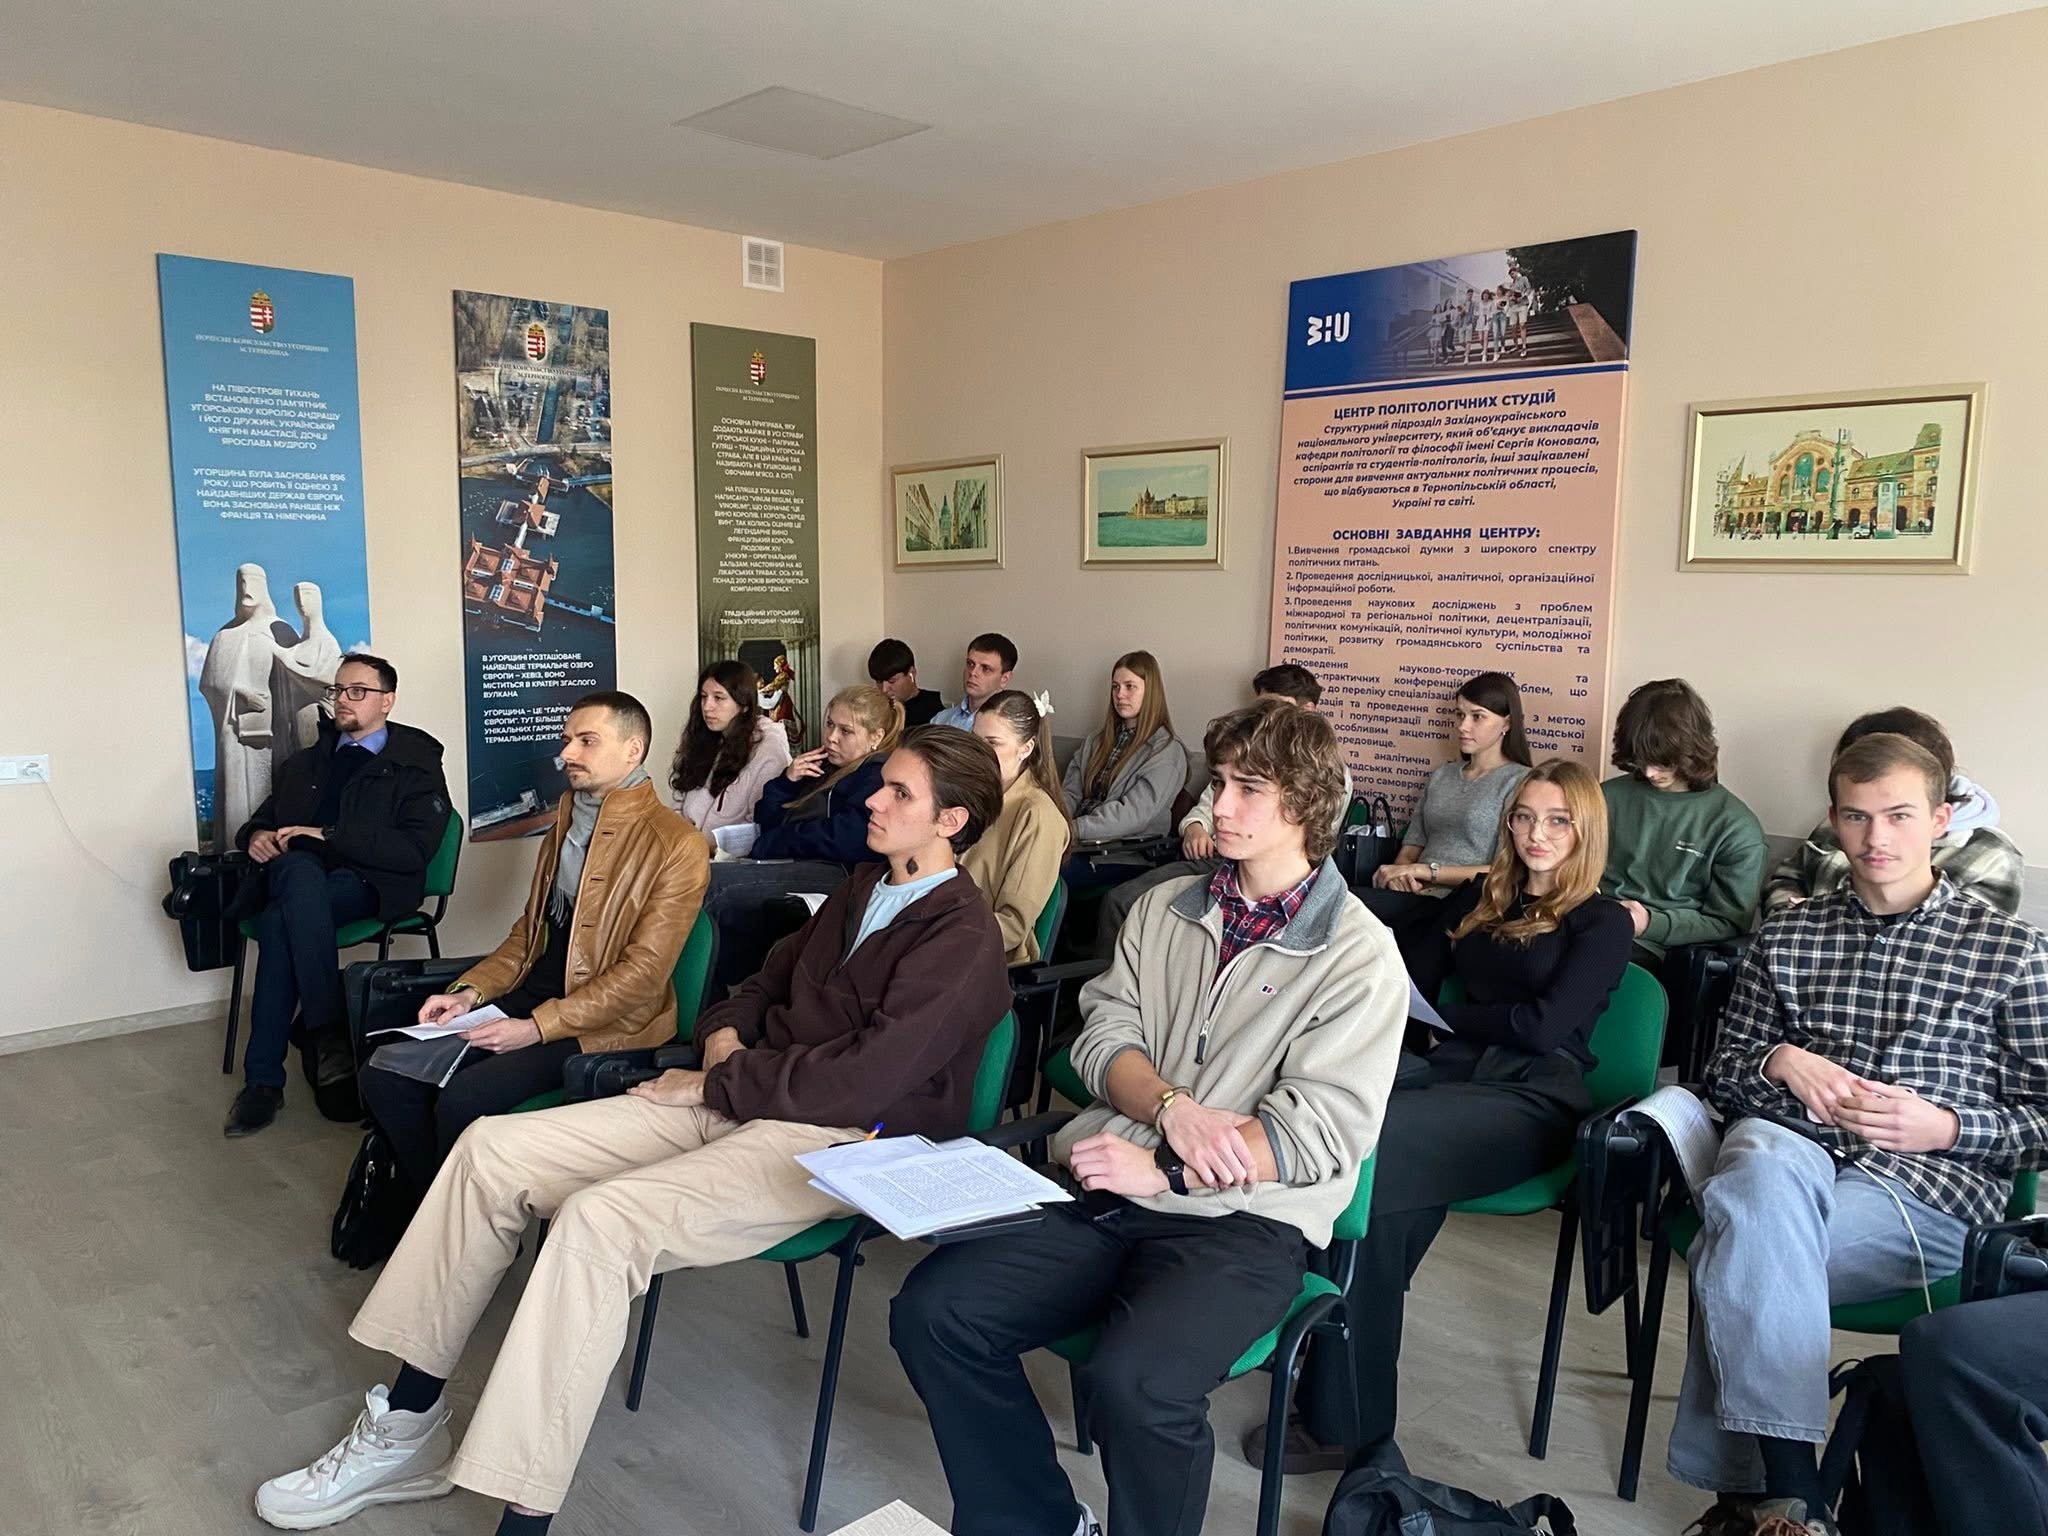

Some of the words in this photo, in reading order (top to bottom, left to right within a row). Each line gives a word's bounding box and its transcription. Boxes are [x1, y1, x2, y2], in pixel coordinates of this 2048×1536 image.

[1334, 406, 1375, 420] ЦЕНТР
[1378, 396, 1497, 416] ПОЛІТОЛОГІЧНИХ
[1502, 389, 1555, 406] СТУДІЙ
[1324, 420, 1389, 435] Структурний
[1391, 416, 1442, 430] підрозділ
[1444, 410, 1566, 426] Західноукраїнського
[1297, 437, 1370, 448] національного
[1372, 432, 1443, 446] університету,
[1446, 428, 1473, 442] який
[1476, 426, 1526, 437] об'єднує
[1529, 420, 1599, 434] викладачів
[1295, 451, 1339, 464] кафедри
[1340, 446, 1395, 462] політології
[1398, 447, 1409, 455] та
[1411, 442, 1463, 459] філософії
[1465, 440, 1494, 455] імені
[1497, 438, 1534, 453] Сергія
[1537, 437, 1599, 452] Коновала,
[1302, 461, 1354, 473] аспірантів
[1357, 462, 1367, 470] та
[1370, 454, 1487, 471] студентів-політологів,
[1490, 452, 1515, 467] інші
[1518, 449, 1589, 462] зацікавлені
[1294, 477, 1333, 486] сторони
[1334, 476, 1353, 487] для
[1355, 473, 1404, 487] вивчення
[1406, 470, 1470, 482] актуальних
[1473, 467, 1538, 480] політичних
[1541, 462, 1598, 477] процесів,
[1341, 485, 1411, 497] відбуваються
[1413, 485, 1419, 493] в
[1423, 480, 1507, 494] Тернопільській
[1509, 478, 1556, 490] області,
[1393, 497, 1432, 510] Україні
[1434, 499, 1446, 507] та
[1448, 495, 1475, 506] світі.
[1333, 529, 1389, 540] ОСНОВНІ
[1396, 528, 1471, 541] ЗАВДАННЯ
[1479, 527, 1540, 540] ЦЕНТРУ:
[1349, 544, 1410, 556] громадської
[1420, 546, 1454, 556] думки
[1481, 546, 1537, 555] широкого
[1548, 546, 1596, 556] спектру
[1288, 557, 1341, 567] політичних
[1295, 571, 1354, 582] Проведення
[1357, 571, 1433, 582] дослідницької,
[1437, 572, 1504, 583] аналітичної,
[1508, 572, 1594, 584] організаційної
[1287, 583, 1356, 594] інформаційної
[1357, 584, 1395, 595] роботи.
[1294, 597, 1352, 607] Проведення
[1368, 600, 1415, 609] наукових
[1432, 599, 1497, 610] досліджень
[1515, 603, 1521, 611] з
[1540, 602, 1592, 614] проблем
[1286, 608, 1346, 619] міжнародної
[1367, 610, 1433, 625] регіональної
[1439, 612, 1490, 624] політики,
[1496, 615, 1592, 628] децентралізації,
[1285, 620, 1337, 634] політичних
[1340, 622, 1403, 634] комунікацій,
[1406, 624, 1462, 635] політичної
[1465, 628, 1519, 639] культури,
[1523, 629, 1591, 642] молодіжної
[1284, 632, 1328, 644] політики,
[1339, 636, 1384, 647] розвитку
[1396, 638, 1482, 649] громадянського
[1495, 641, 1563, 653] суспільства
[1578, 646, 1590, 654] та
[489, 654, 528, 662] УГОРЩИНІ
[528, 653, 581, 661] РОЗТАШОВАНЕ
[1283, 646, 1335, 656] демократії.
[482, 663, 526, 671] НАЙБІЛЬШЕ
[527, 662, 569, 670] ТЕРМАЛЬНЕ
[570, 661, 594, 669] ОЗЕРО
[483, 672, 514, 680] ЄВРОПИ
[483, 681, 524, 689] МІСТИТЬСЯ
[483, 690, 518, 698] ВУЛКАНА
[484, 708, 526, 717] УГОРЩИНА
[532, 707, 543, 715] ЦЕ
[521, 716, 534, 724] ТУТ
[1533, 714, 1539, 722] з
[1547, 716, 1586, 726] метою
[484, 726, 531, 735] УНІКАЛЬНИХ
[1334, 724, 1388, 736] особливим
[1400, 729, 1450, 740] акцентом
[485, 734, 534, 744] ТЕРМАЛЬНИХ
[1349, 750, 1359, 758] та
[1374, 752, 1432, 765] аналітична
